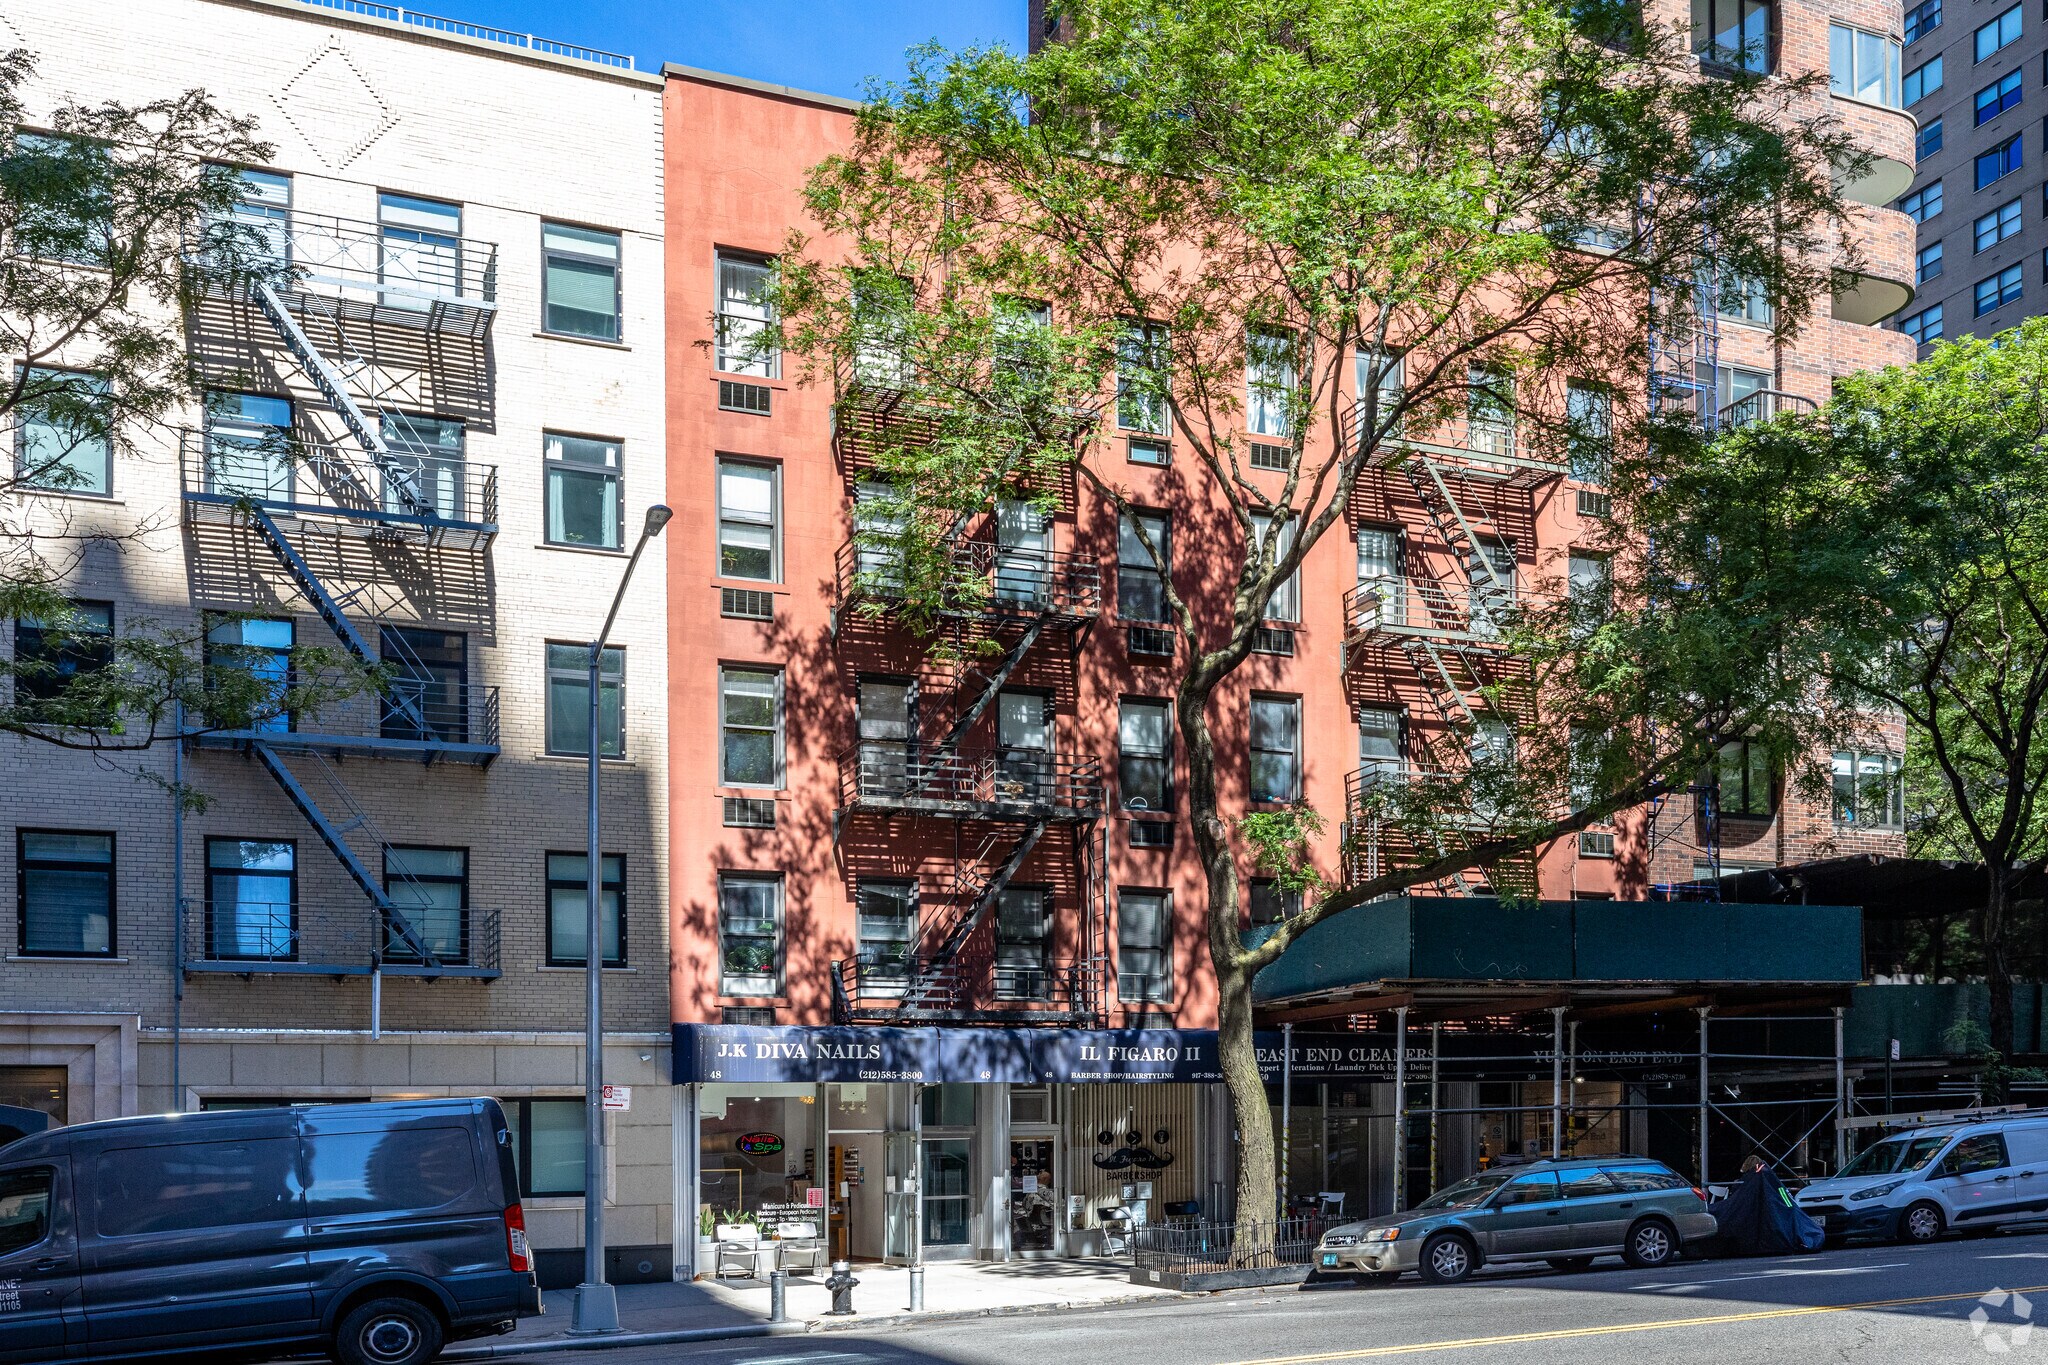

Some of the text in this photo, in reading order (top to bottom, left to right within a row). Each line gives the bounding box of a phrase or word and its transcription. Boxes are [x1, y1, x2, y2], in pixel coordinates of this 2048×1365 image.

[718, 1043, 881, 1059] J.K DIVA NAILS
[1080, 1046, 1201, 1061] IL FIGARO II
[1255, 1047, 1300, 1062] EAST
[1305, 1048, 1343, 1062] END
[1608, 1050, 1647, 1064] EAST
[1334, 1063, 1366, 1073] Laundry
[1369, 1063, 1385, 1071] Pick
[710, 1070, 722, 1080] 48
[858, 1070, 923, 1080] (212)585-3800
[979, 1071, 992, 1080] 48
[741, 1135, 776, 1143] Nails
[753, 1142, 782, 1152] Spa
[1106, 1171, 1162, 1180] BARBERSHOP
